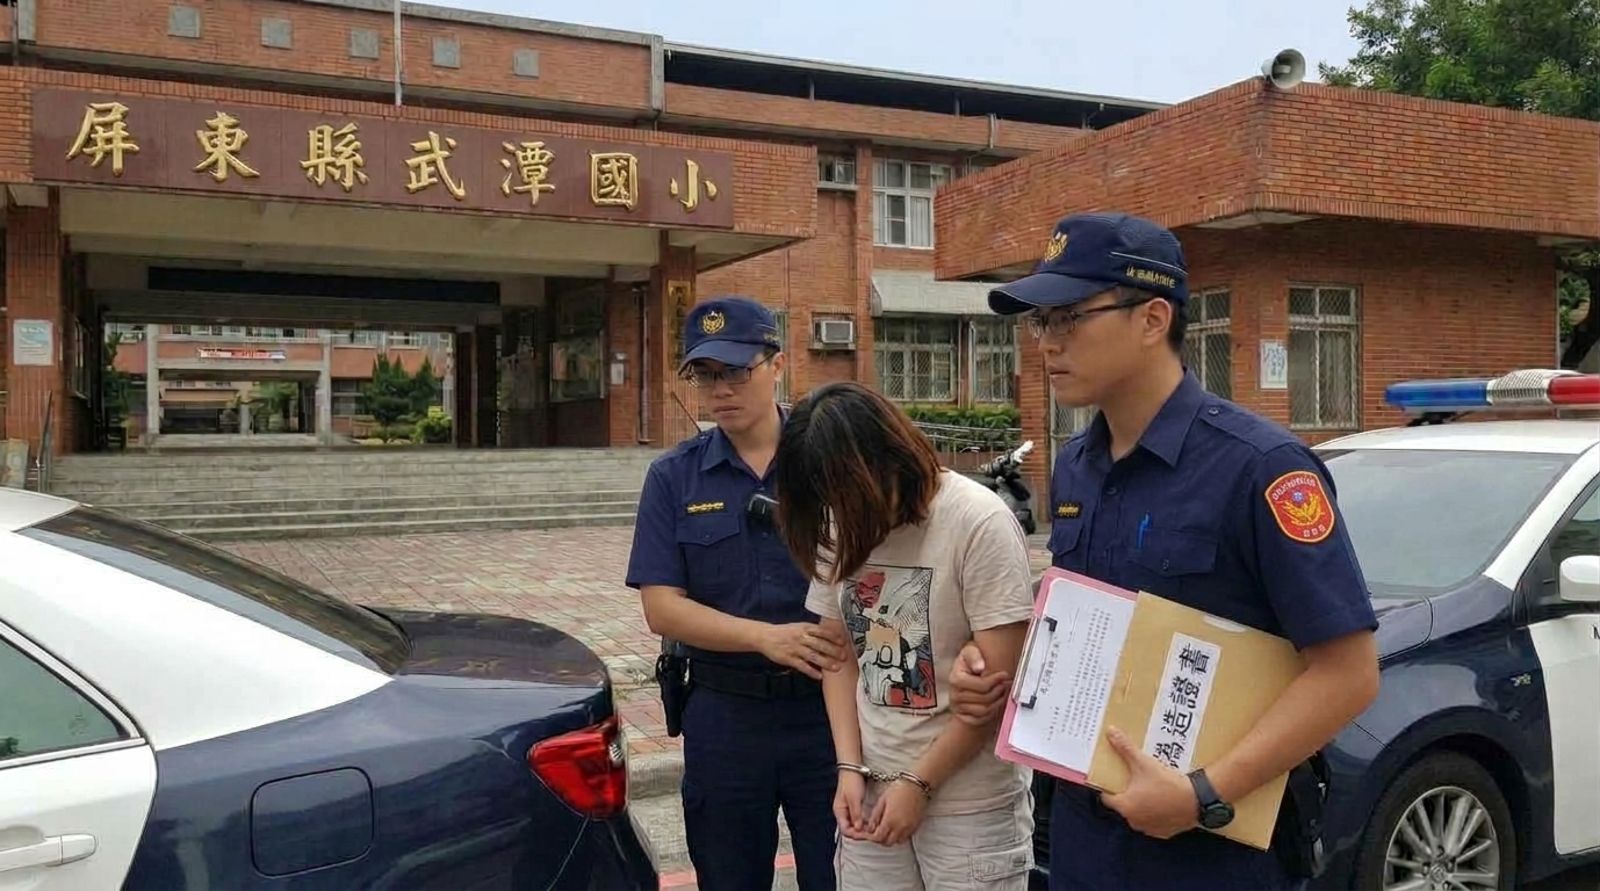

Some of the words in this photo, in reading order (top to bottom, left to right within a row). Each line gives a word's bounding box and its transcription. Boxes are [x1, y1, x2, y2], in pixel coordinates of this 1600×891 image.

[65, 101, 718, 213] 屏東縣武潭國小
